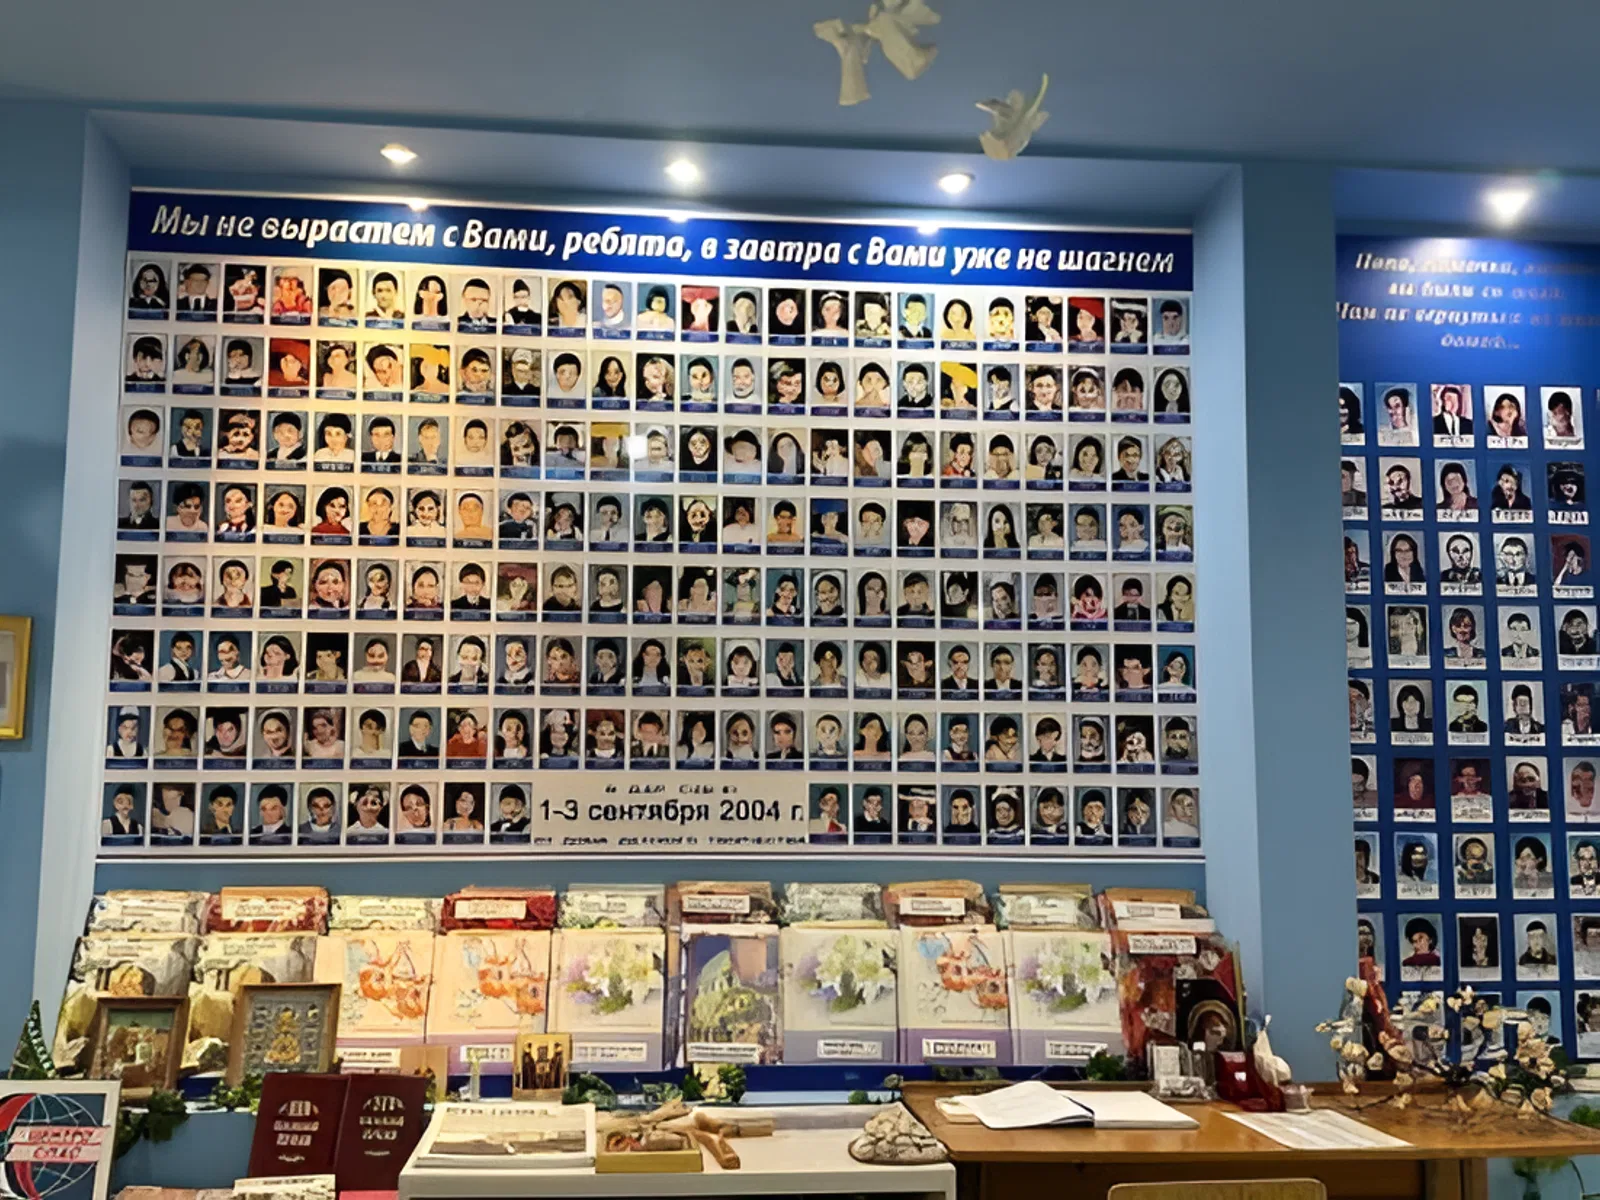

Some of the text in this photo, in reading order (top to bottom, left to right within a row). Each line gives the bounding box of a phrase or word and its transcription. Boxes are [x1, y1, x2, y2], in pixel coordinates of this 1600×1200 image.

[151, 205, 1175, 276] Мы не вырастем с Вами, ребята, в завтра с Вами уже не шагнем
[540, 799, 579, 821] 1-3
[588, 798, 709, 826] сентября
[719, 799, 780, 821] 2004
